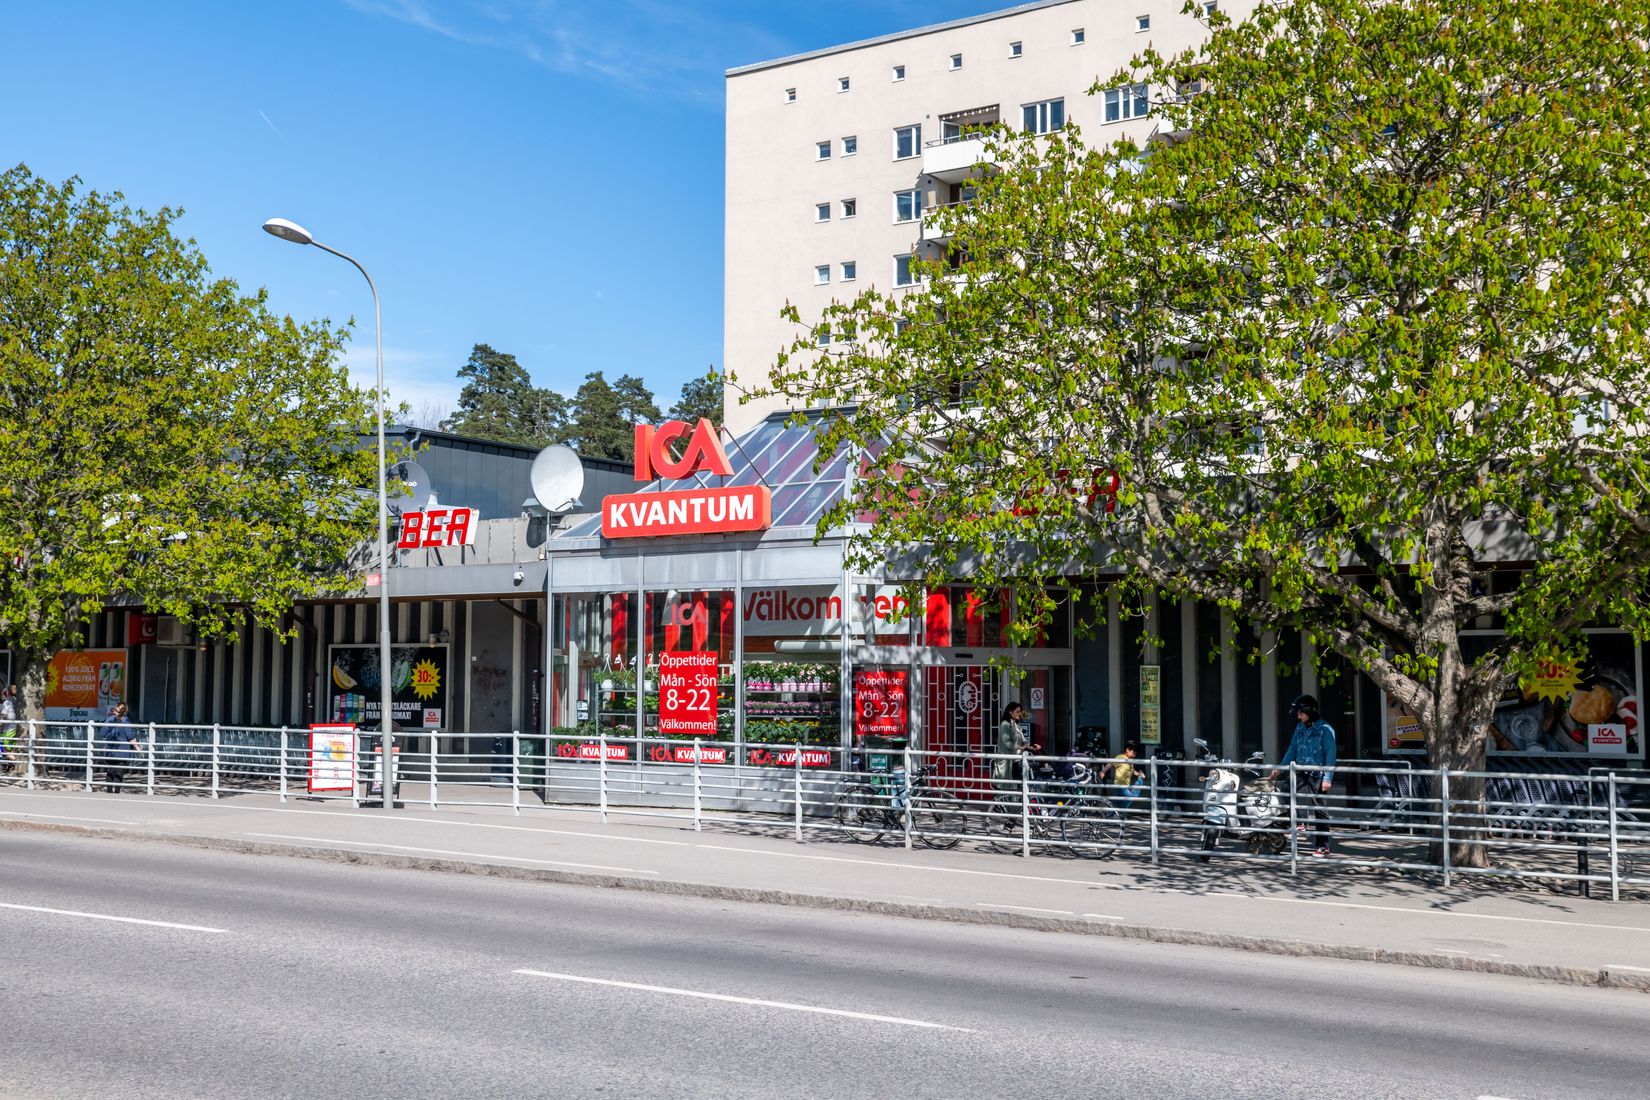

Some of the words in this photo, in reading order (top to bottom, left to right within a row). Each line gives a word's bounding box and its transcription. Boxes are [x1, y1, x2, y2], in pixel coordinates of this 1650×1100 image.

[634, 417, 734, 481] ICA
[610, 494, 754, 529] KVANTUM
[397, 508, 471, 549] BEA
[671, 601, 707, 626] ICA
[661, 652, 716, 669] Öppettider
[418, 670, 434, 683] 30:-
[661, 673, 685, 687] Mån
[695, 673, 716, 687] Sön
[859, 675, 904, 687] Öppettider
[666, 689, 710, 711] 8-22
[858, 690, 878, 700] Mån
[887, 690, 904, 700] Sön
[863, 701, 899, 718] 8-22
[660, 719, 717, 731] Välkommen!
[1598, 728, 1616, 737] ICA
[557, 744, 578, 757] ICA
[582, 746, 626, 757] KVATUM
[651, 746, 673, 761] ICA
[750, 749, 774, 765] ICA
